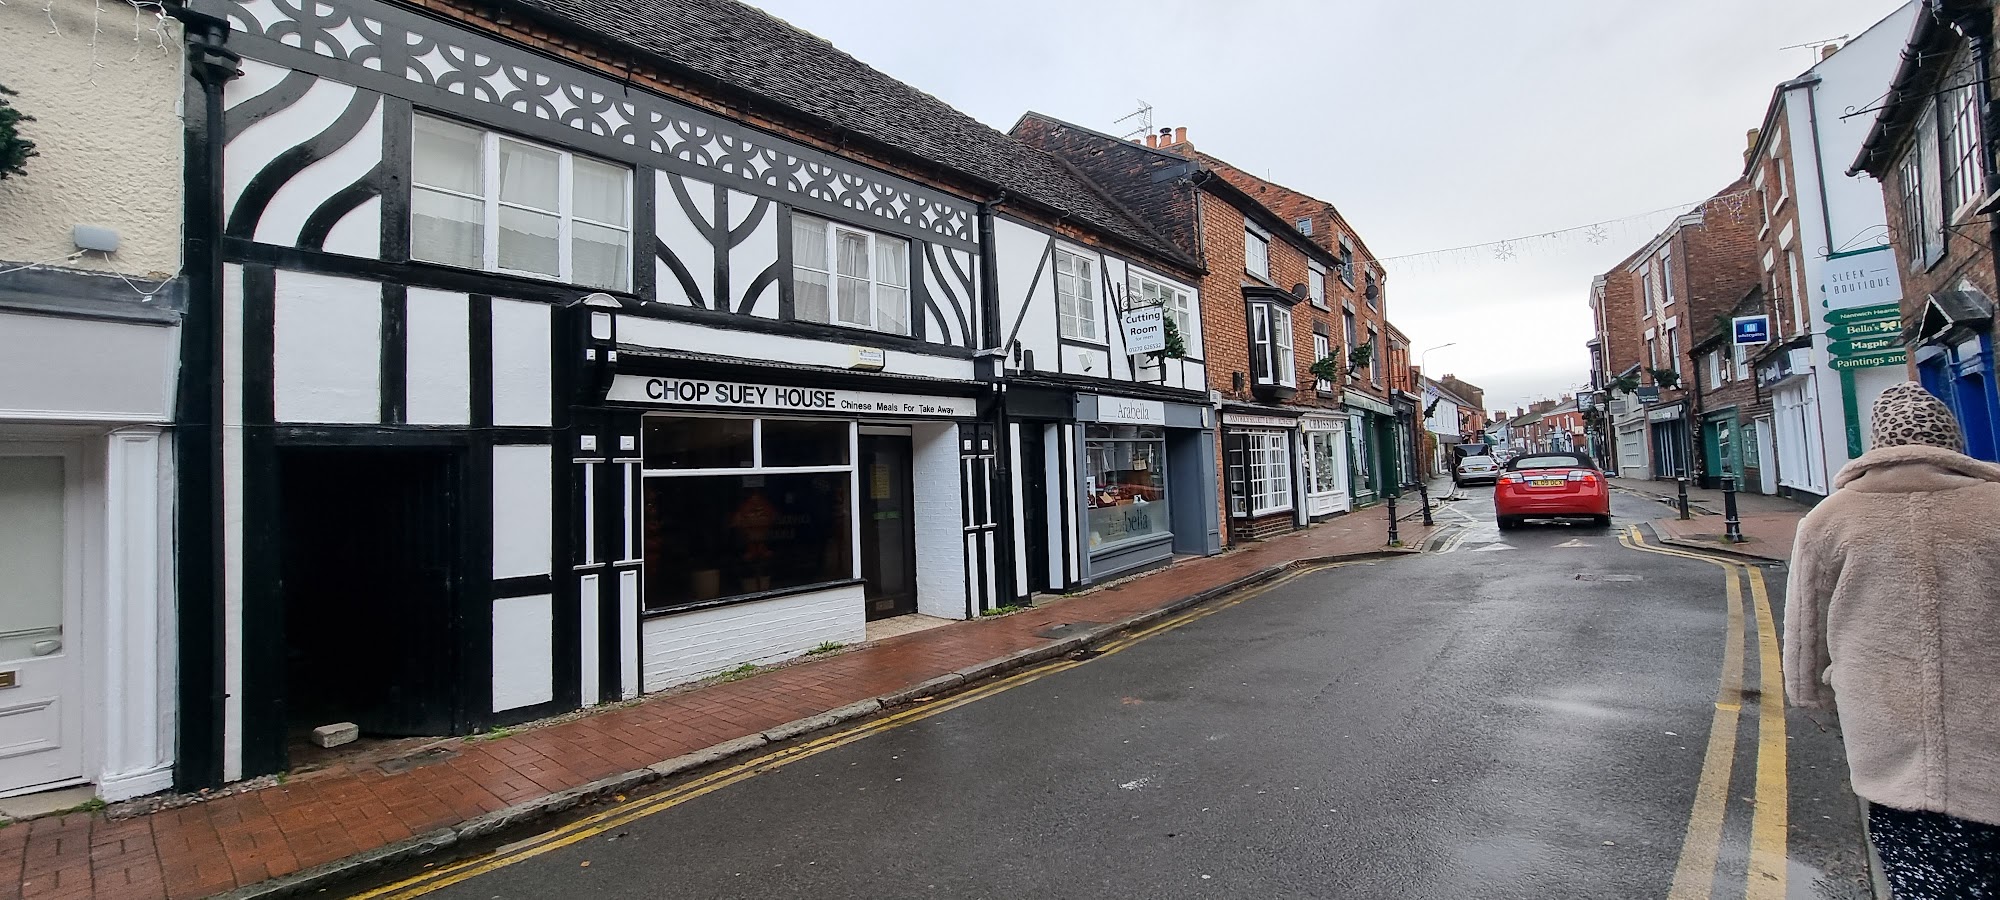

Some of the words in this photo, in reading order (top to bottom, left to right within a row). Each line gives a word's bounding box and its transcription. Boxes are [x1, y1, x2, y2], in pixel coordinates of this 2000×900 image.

[1832, 269, 1865, 283] SLEEK
[1834, 276, 1891, 295] BOUTIQUE
[1126, 312, 1161, 324] Cutting
[1130, 325, 1158, 336] Room
[1847, 323, 1880, 334] Bella's
[1851, 339, 1889, 350] Magpie
[1837, 355, 1885, 368] Paintings
[646, 379, 710, 402] CHOP
[715, 383, 767, 404] SUEY
[775, 387, 836, 409] HOUSE
[841, 399, 872, 411] Chinese
[876, 402, 898, 412] Meals
[903, 403, 915, 412] For
[919, 404, 935, 414] Take
[937, 405, 954, 415] Away
[1117, 402, 1150, 420] Arabella
